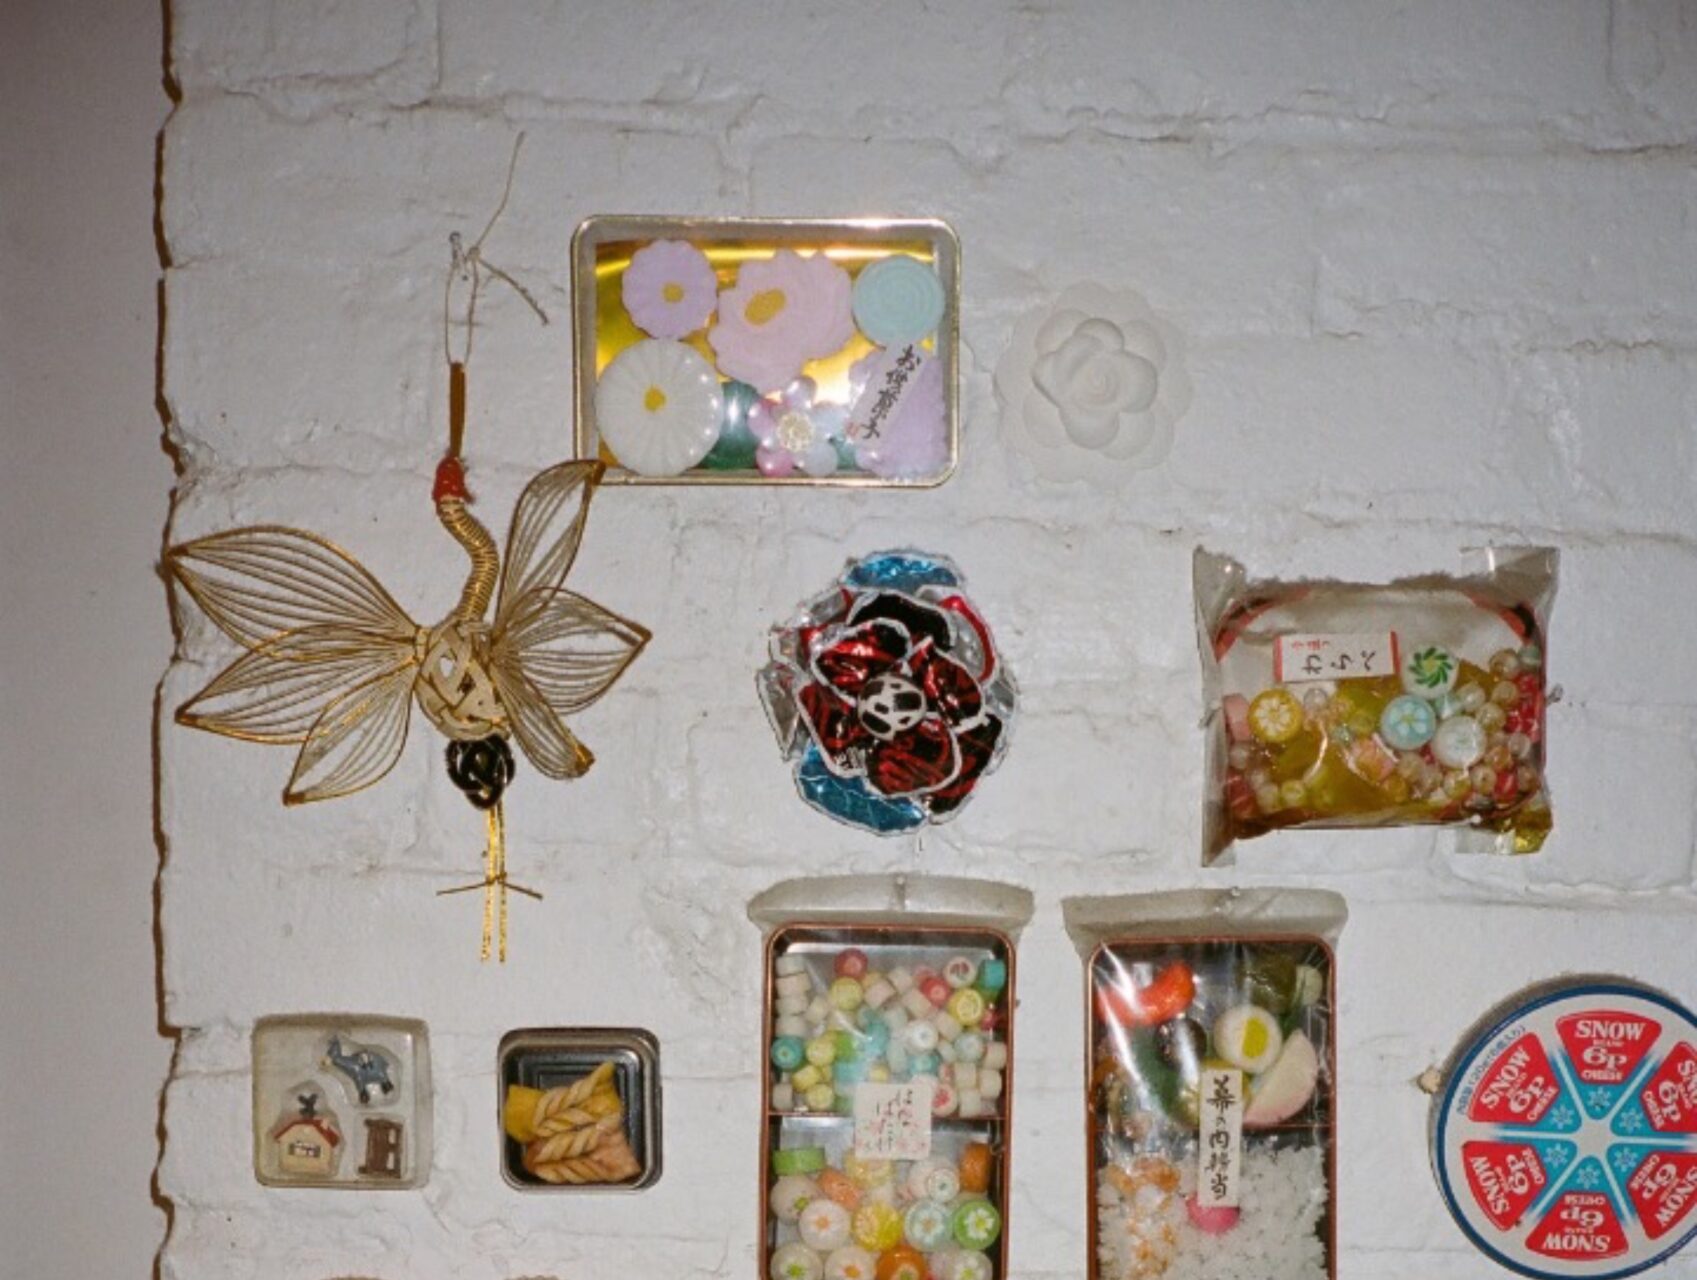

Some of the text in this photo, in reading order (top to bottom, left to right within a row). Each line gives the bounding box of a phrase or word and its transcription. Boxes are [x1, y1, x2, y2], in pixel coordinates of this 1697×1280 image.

[1575, 1018, 1646, 1041] SNOW
[1480, 1046, 1532, 1110] SNOW
[1469, 1154, 1511, 1216] SNOW
[1542, 1233, 1611, 1253] SNOW
